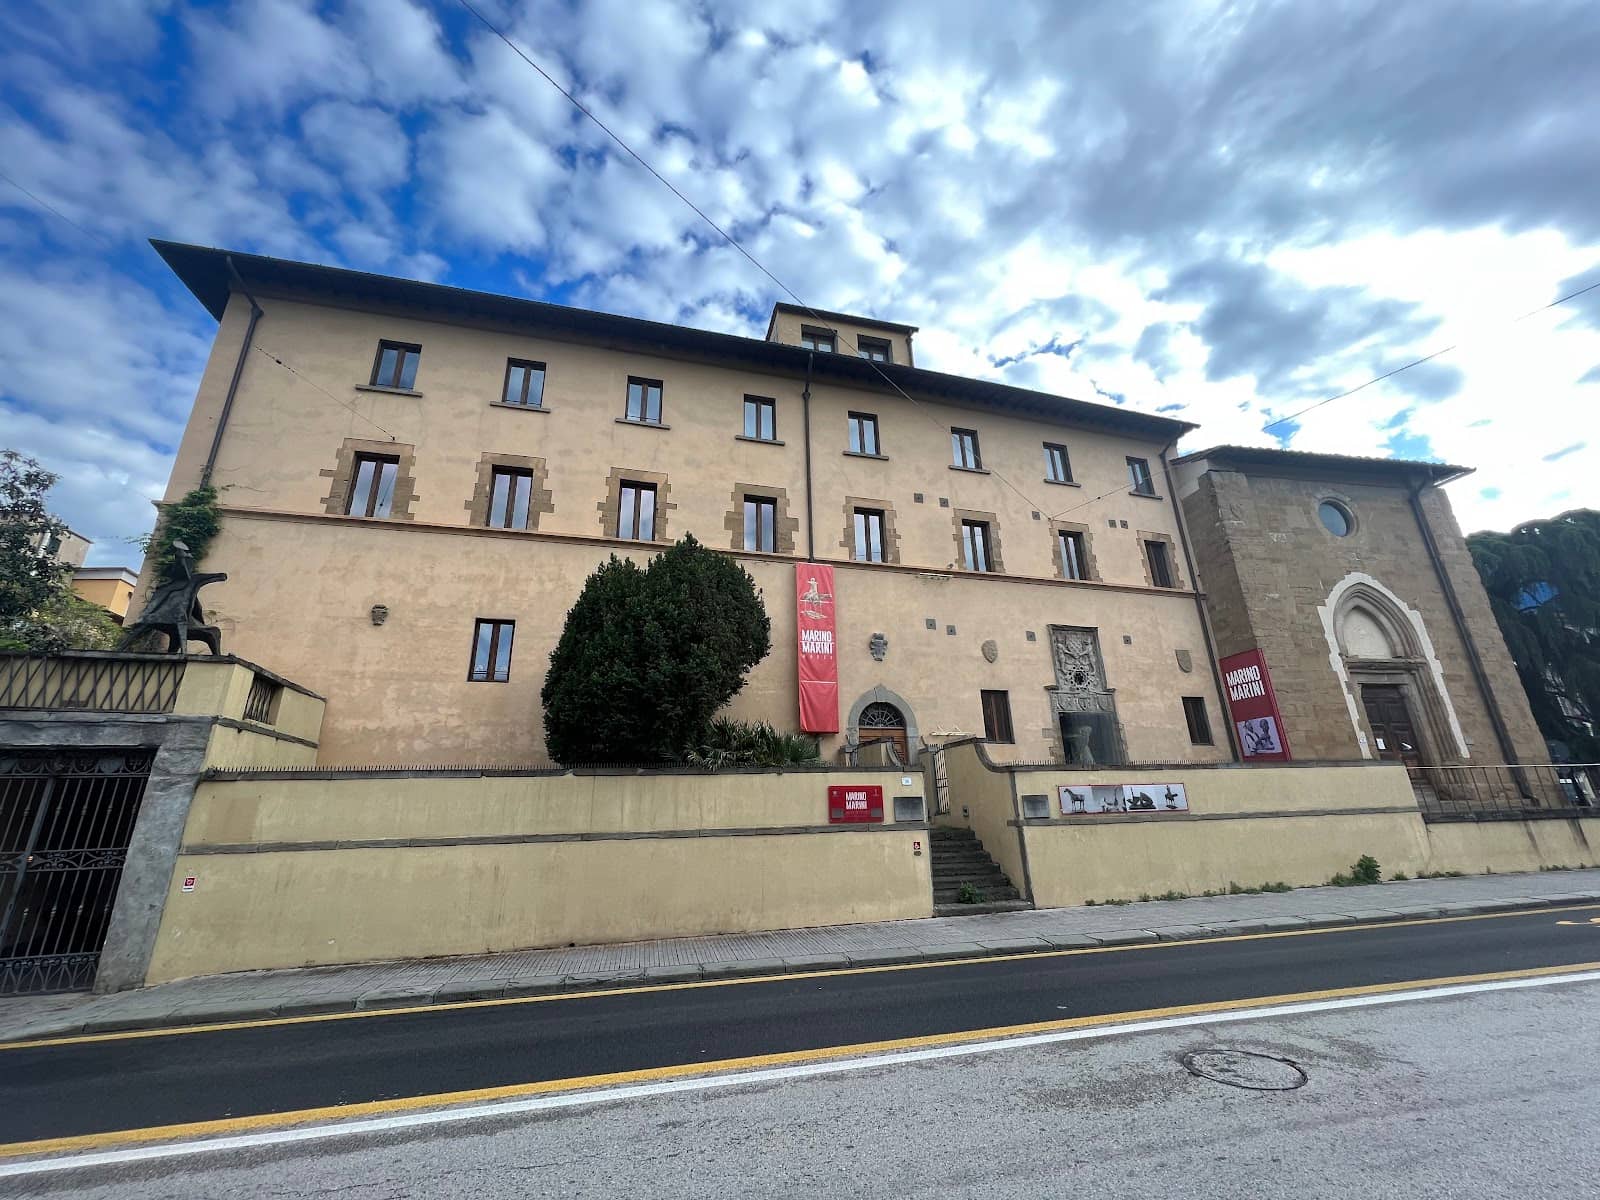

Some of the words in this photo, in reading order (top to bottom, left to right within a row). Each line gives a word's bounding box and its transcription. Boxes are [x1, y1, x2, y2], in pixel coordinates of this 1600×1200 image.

[802, 630, 832, 641] MARINO
[802, 642, 832, 654] MARINI
[1226, 665, 1260, 685] MARINO
[1230, 680, 1265, 702] MARINI
